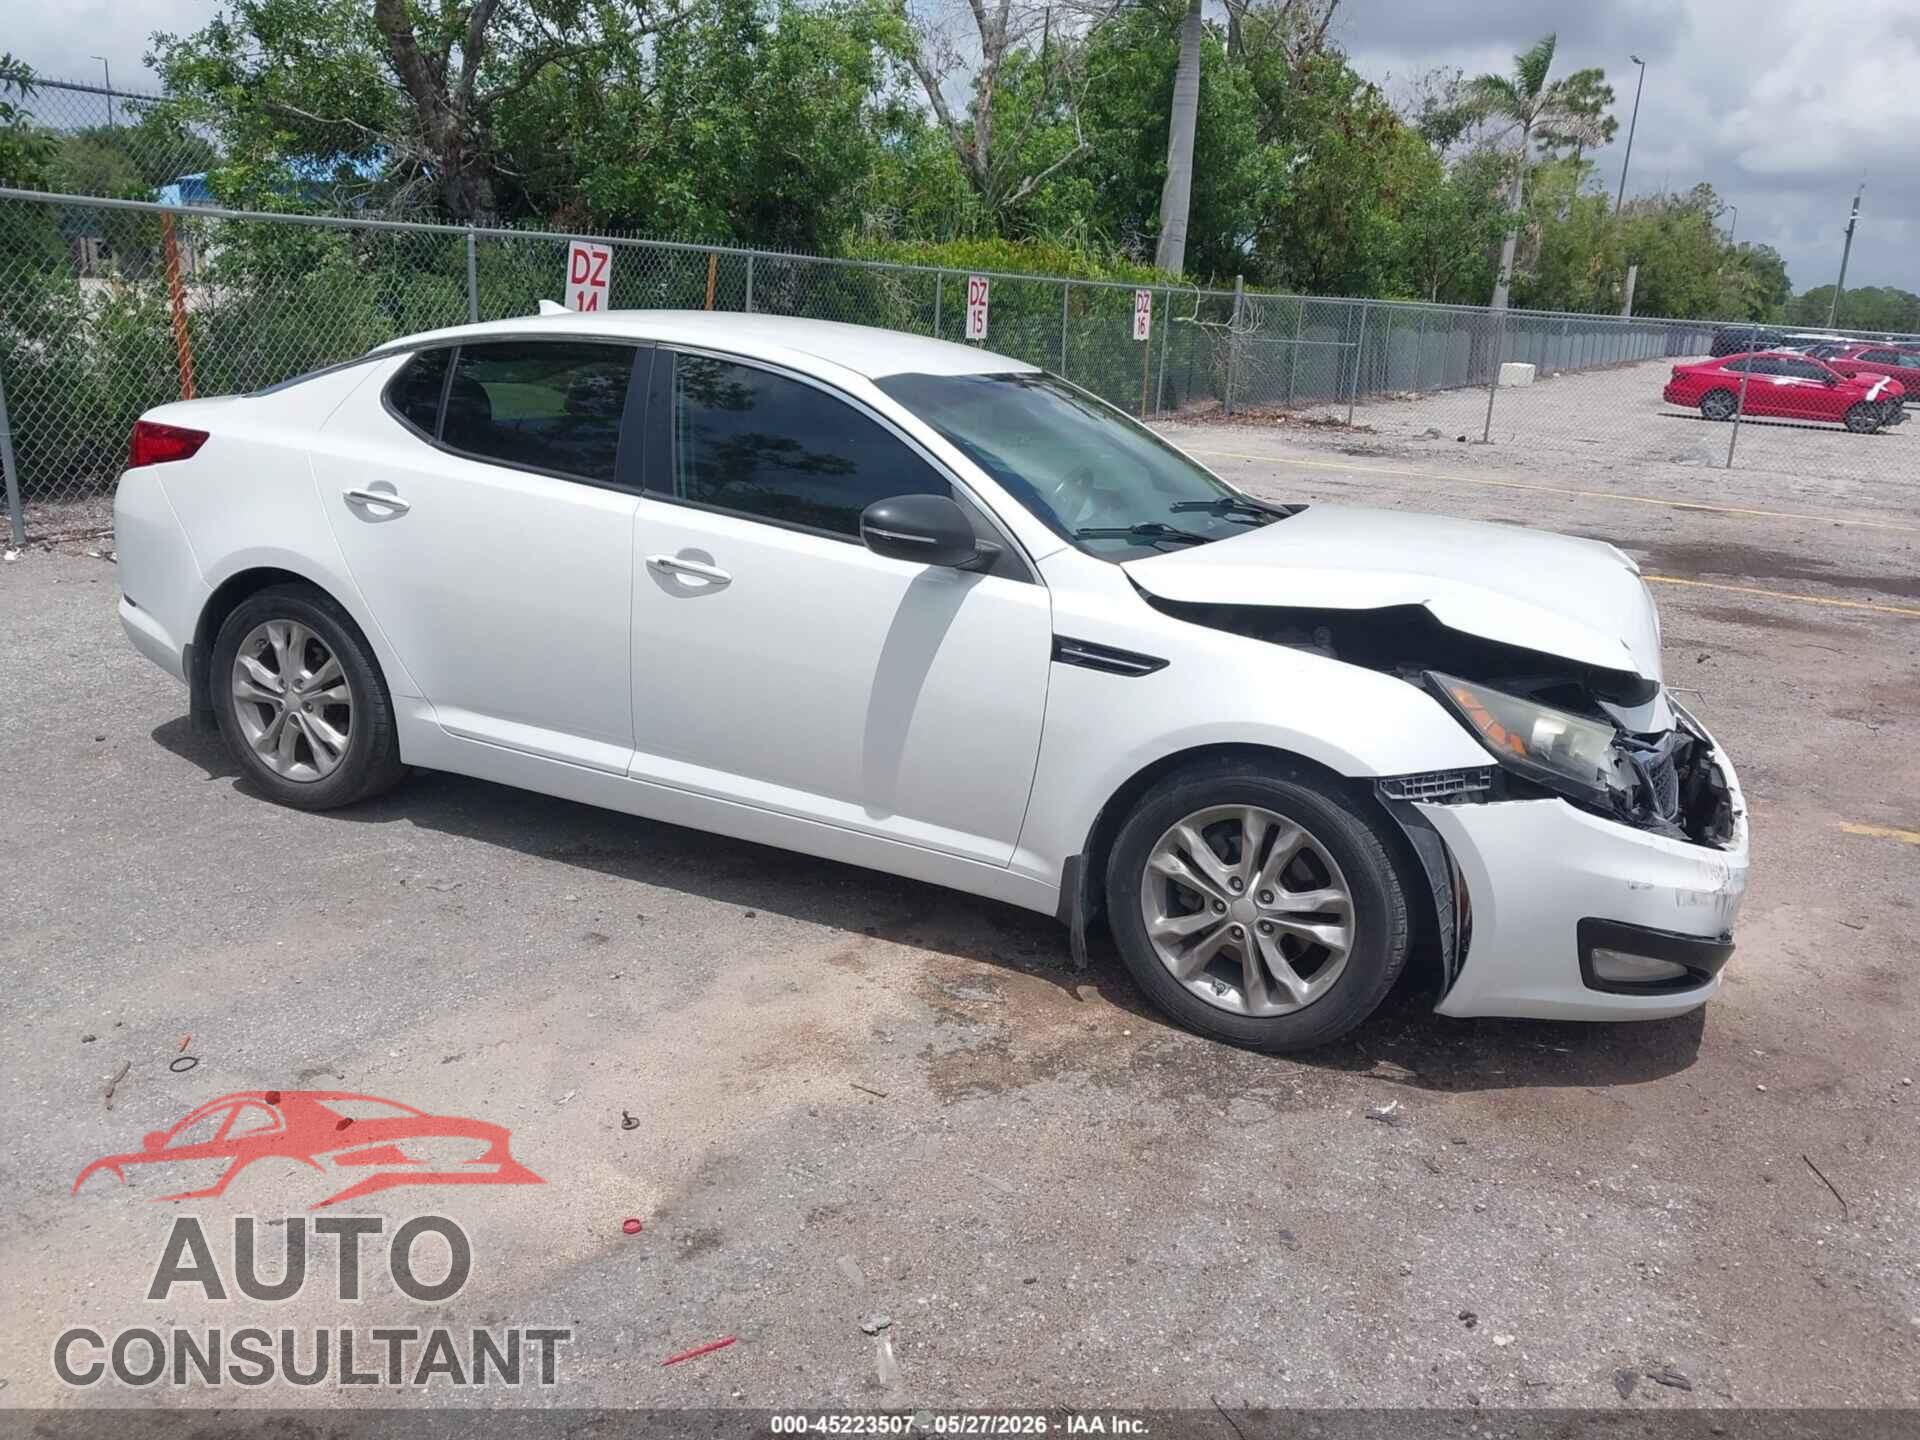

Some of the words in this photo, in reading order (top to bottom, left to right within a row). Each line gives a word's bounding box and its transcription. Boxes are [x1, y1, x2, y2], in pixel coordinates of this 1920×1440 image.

[572, 248, 608, 287] DZ
[970, 281, 987, 306] DZ
[1137, 294, 1150, 313] DZ
[972, 310, 984, 334] 15
[1137, 316, 1146, 335] 16
